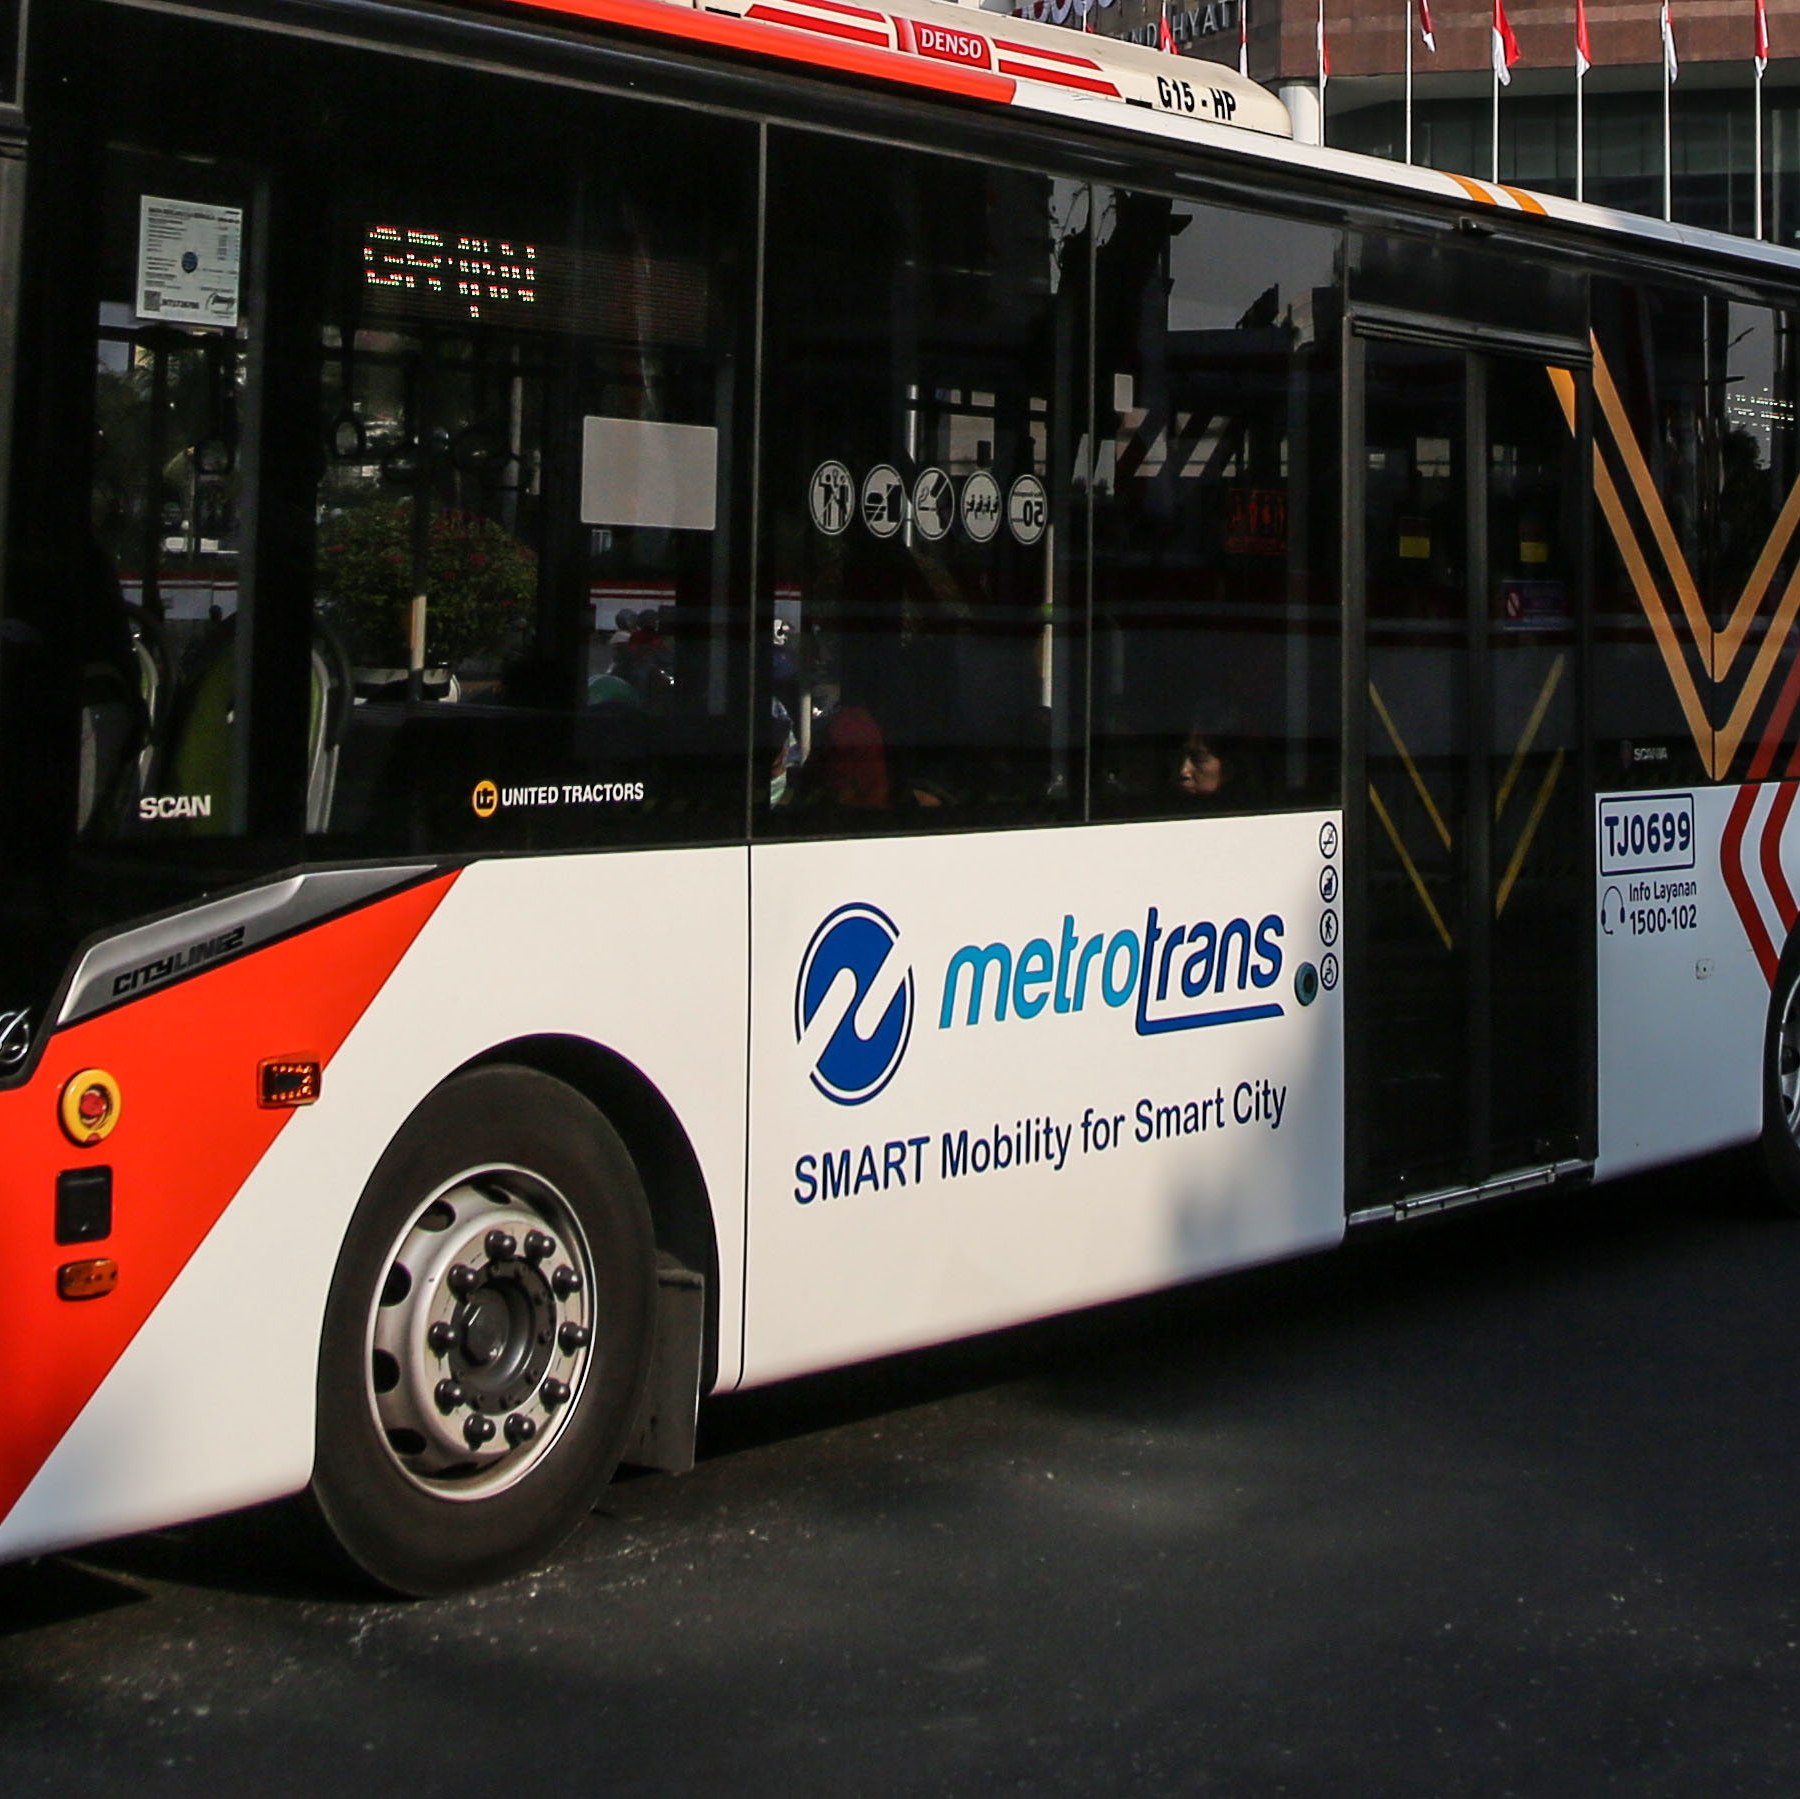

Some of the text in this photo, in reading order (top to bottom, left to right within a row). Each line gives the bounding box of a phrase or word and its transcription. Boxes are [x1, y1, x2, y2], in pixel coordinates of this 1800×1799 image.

[920, 27, 983, 60] DENSO
[1156, 75, 1194, 113] G15
[1209, 87, 1237, 122] HP
[501, 786, 559, 806] UNITED
[562, 782, 644, 803] TRACTORS
[1604, 811, 1692, 857] TJ0699
[1629, 880, 1697, 903] Info Layanan
[1629, 904, 1697, 935] 1500-102
[939, 906, 1285, 1036] metrotrans
[793, 1079, 1288, 1205] SMART Mobility for Smart City
